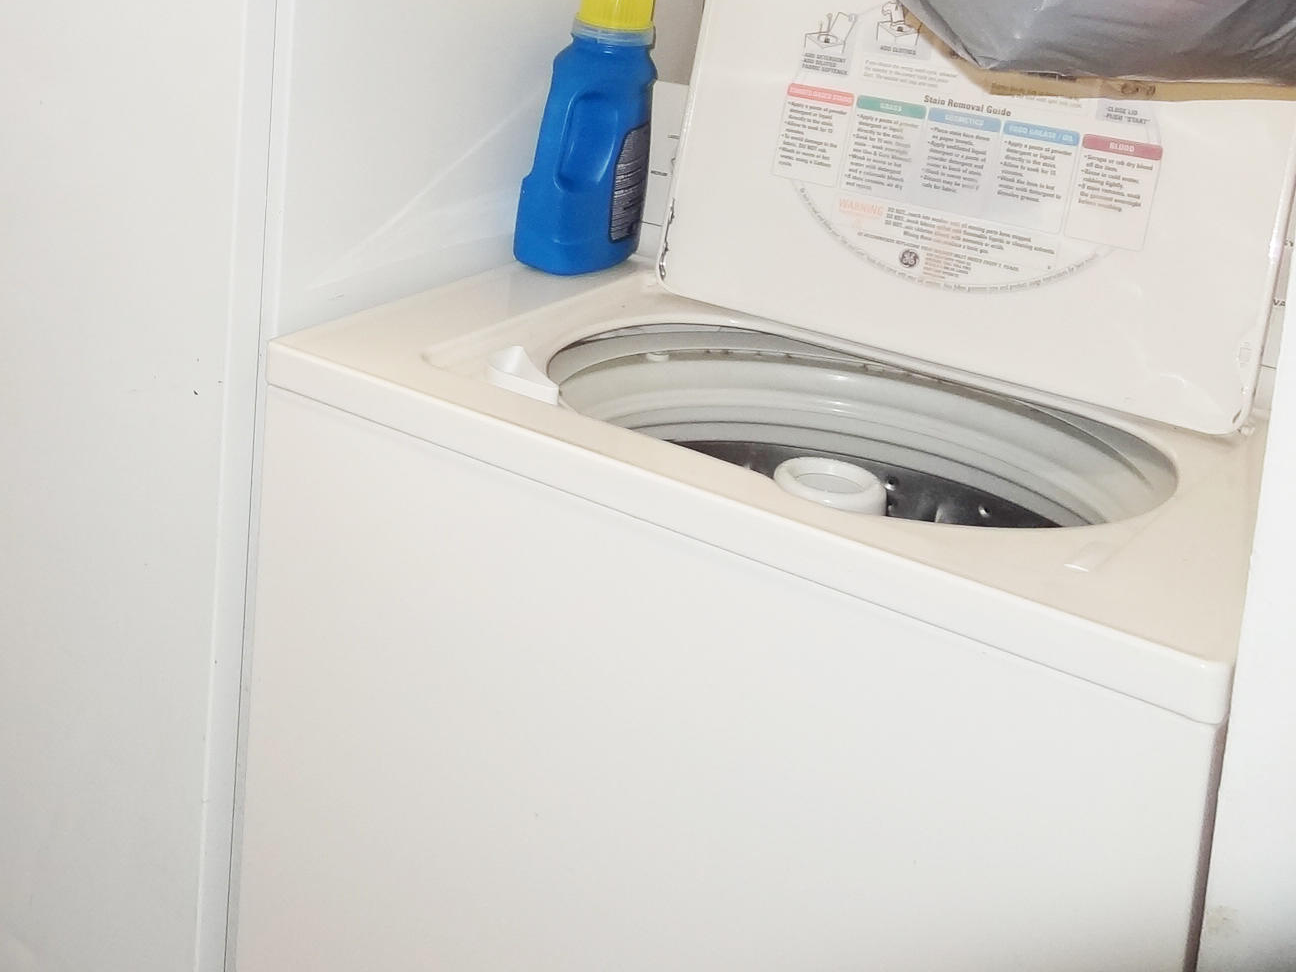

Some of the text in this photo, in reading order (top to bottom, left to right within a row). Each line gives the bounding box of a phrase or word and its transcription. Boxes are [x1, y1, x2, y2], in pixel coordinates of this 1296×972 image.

[924, 95, 1012, 116] Stain Removal Guide
[1109, 141, 1135, 152] BLOOD
